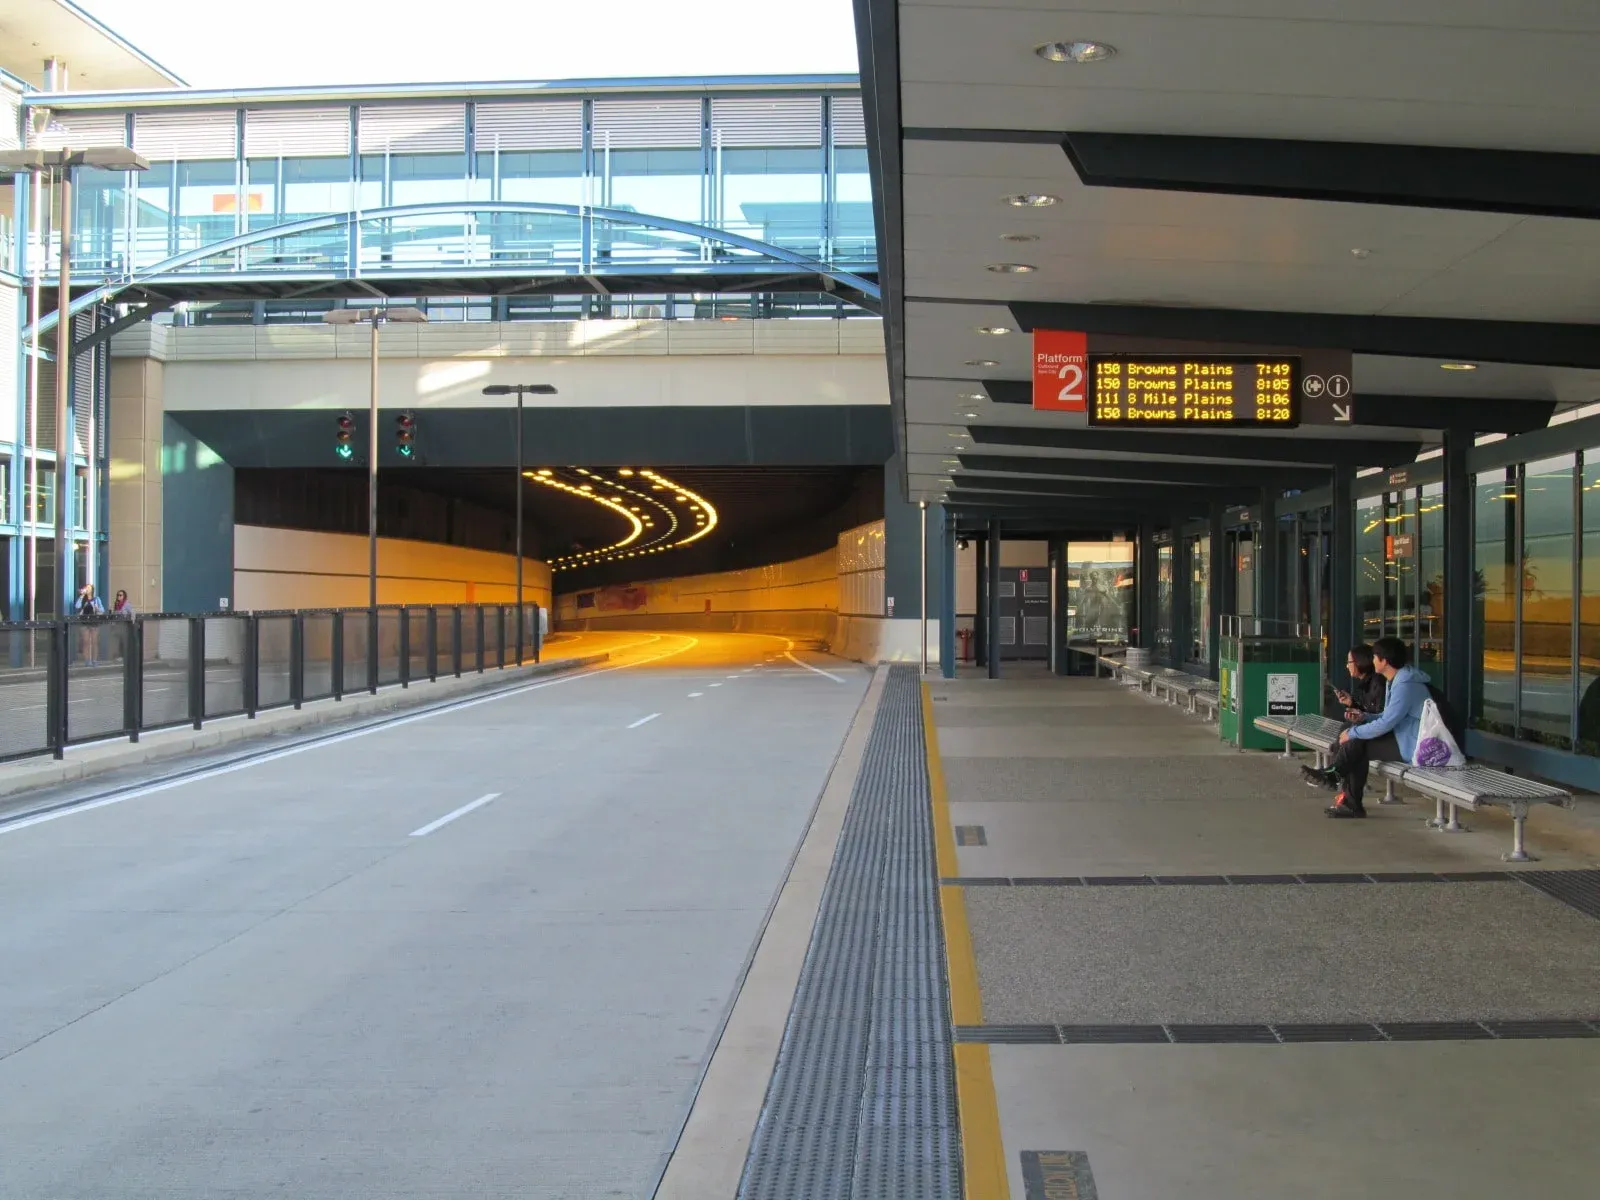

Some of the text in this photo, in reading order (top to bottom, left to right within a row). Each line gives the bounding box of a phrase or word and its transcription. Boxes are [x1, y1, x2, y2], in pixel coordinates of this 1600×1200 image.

[1037, 353, 1083, 363] Platform
[1096, 362, 1289, 375] 150 Browns Plains 7:49
[1058, 364, 1083, 401] 2
[1096, 377, 1289, 390] 150 Browns Plains 8:05
[1096, 392, 1289, 405] 111 8 Mile Plains 8:06
[1096, 406, 1289, 420] 150 Browns Plains 8:20
